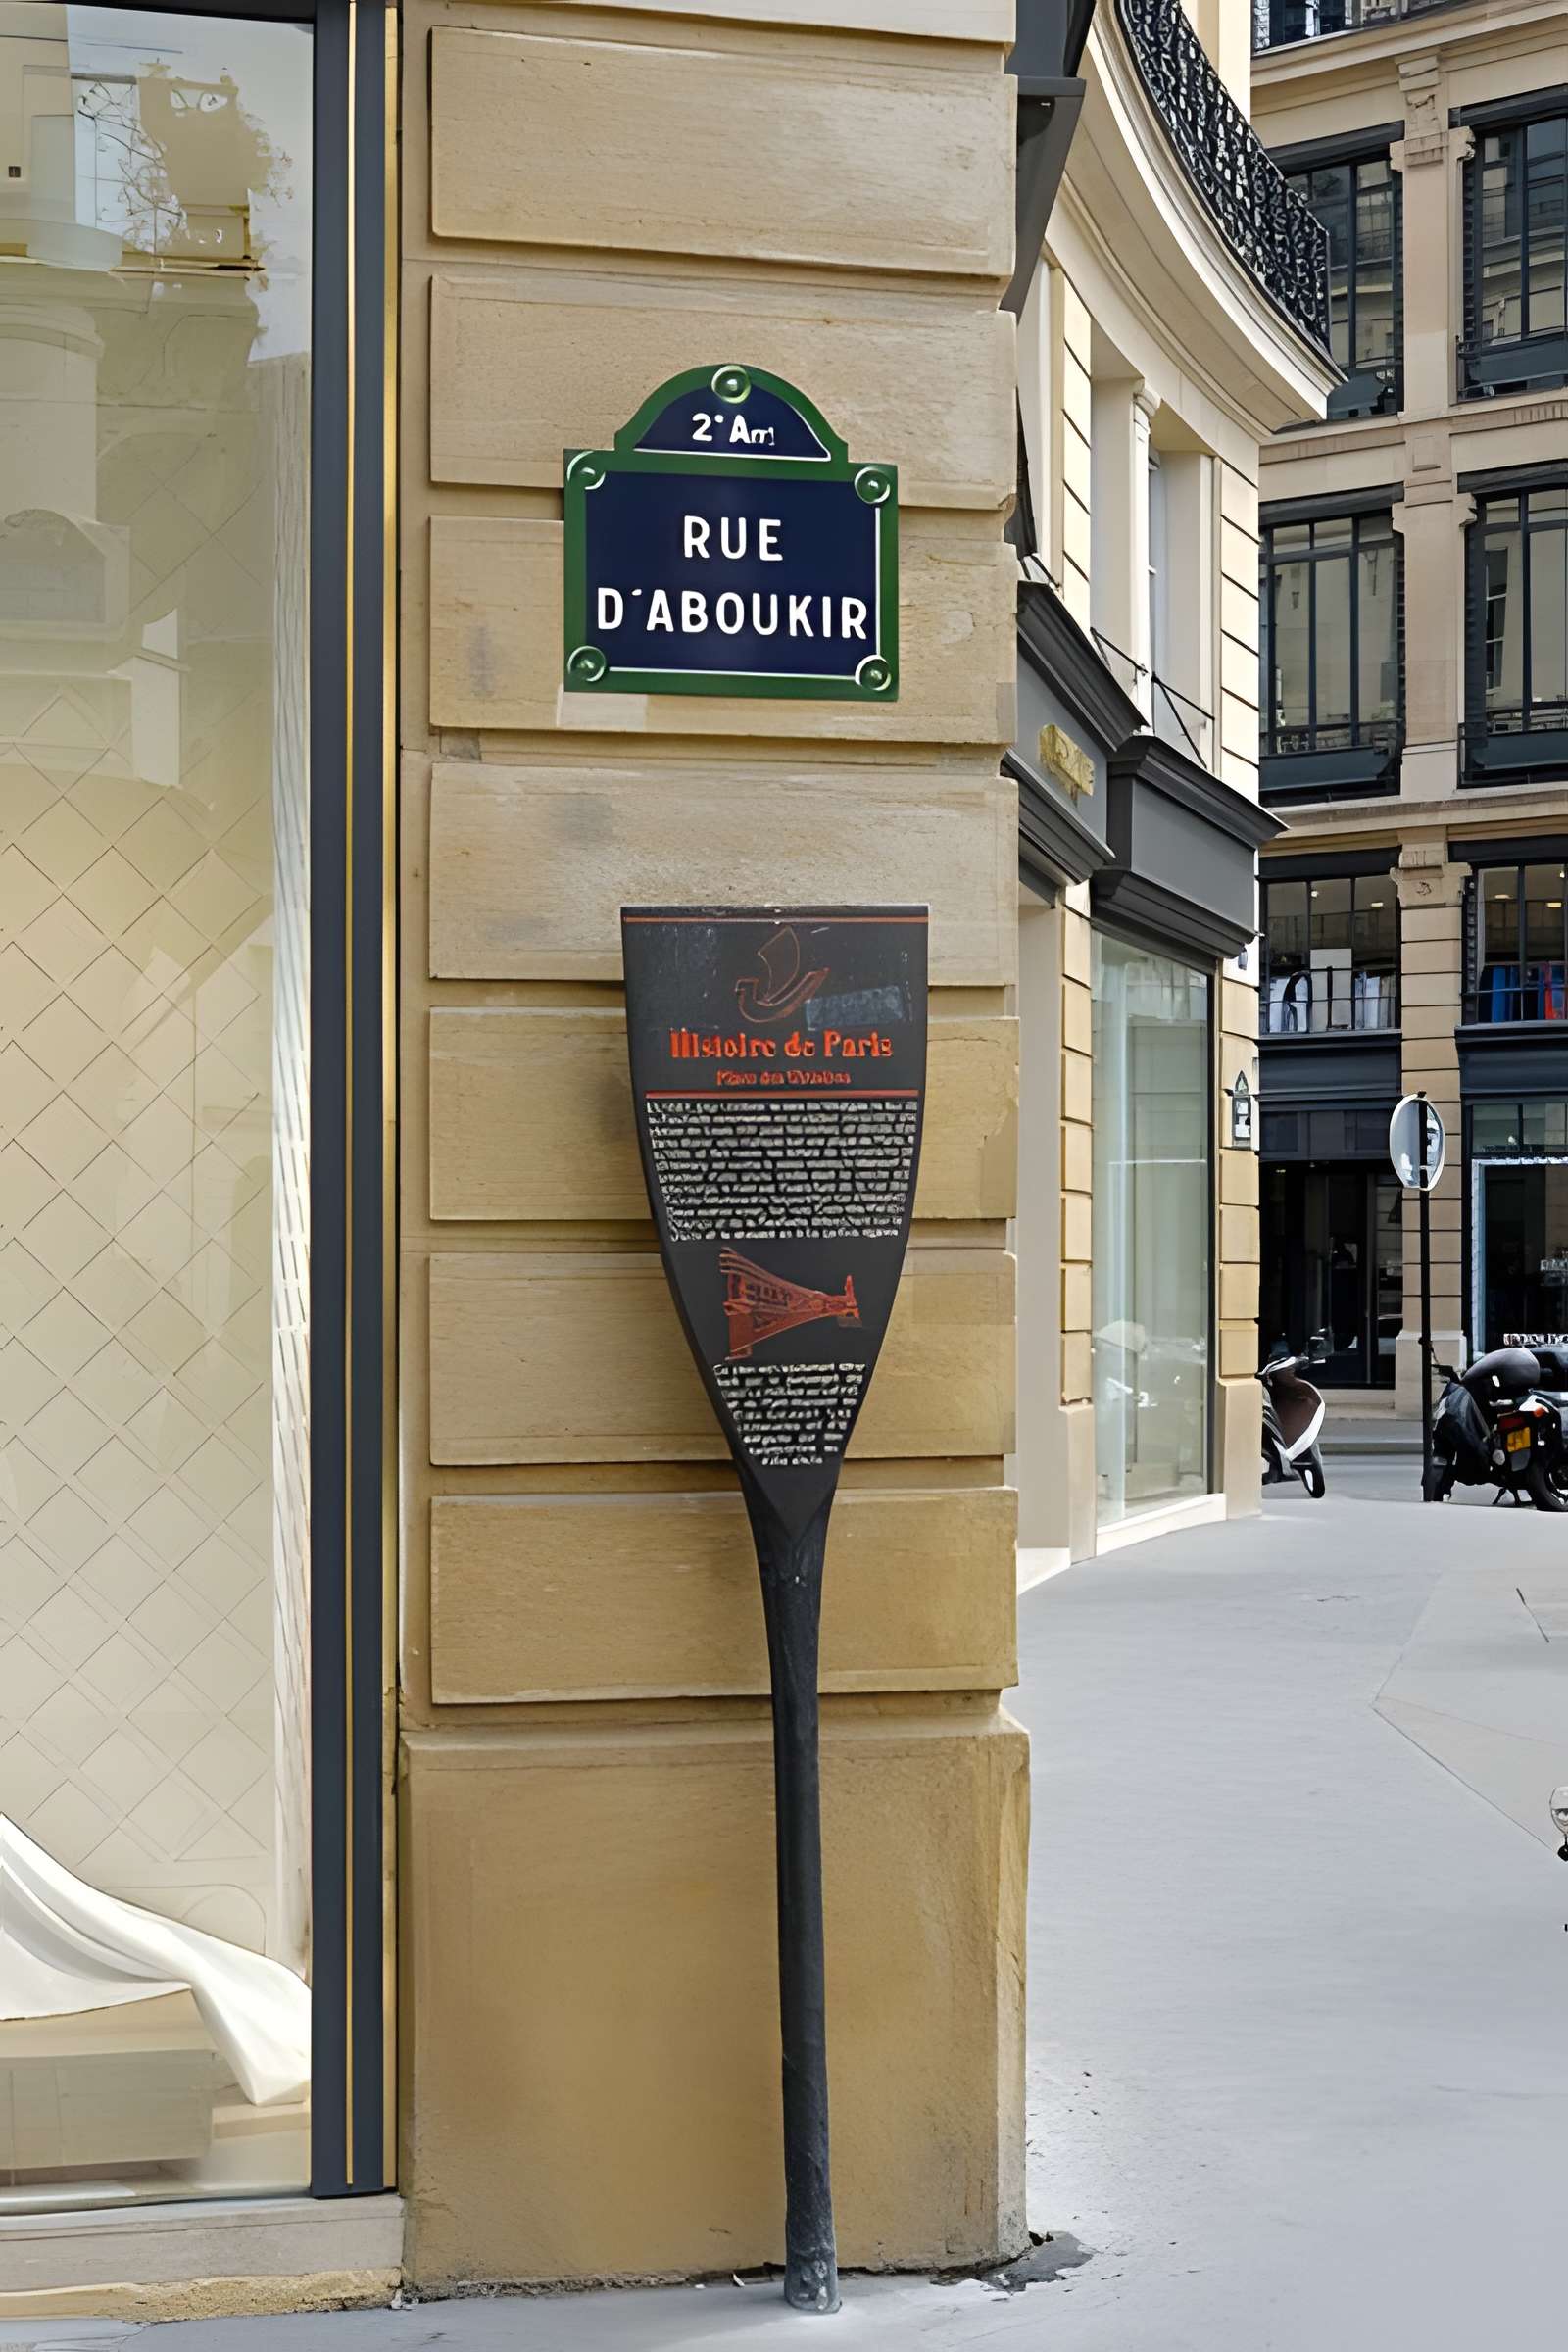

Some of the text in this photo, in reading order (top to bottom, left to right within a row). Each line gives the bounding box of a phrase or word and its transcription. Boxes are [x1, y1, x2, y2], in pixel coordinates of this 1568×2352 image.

[684, 515, 783, 561] RUE
[597, 587, 867, 640] D'ABOUKIR
[784, 1031, 815, 1057] de
[823, 1030, 893, 1058] Paris
